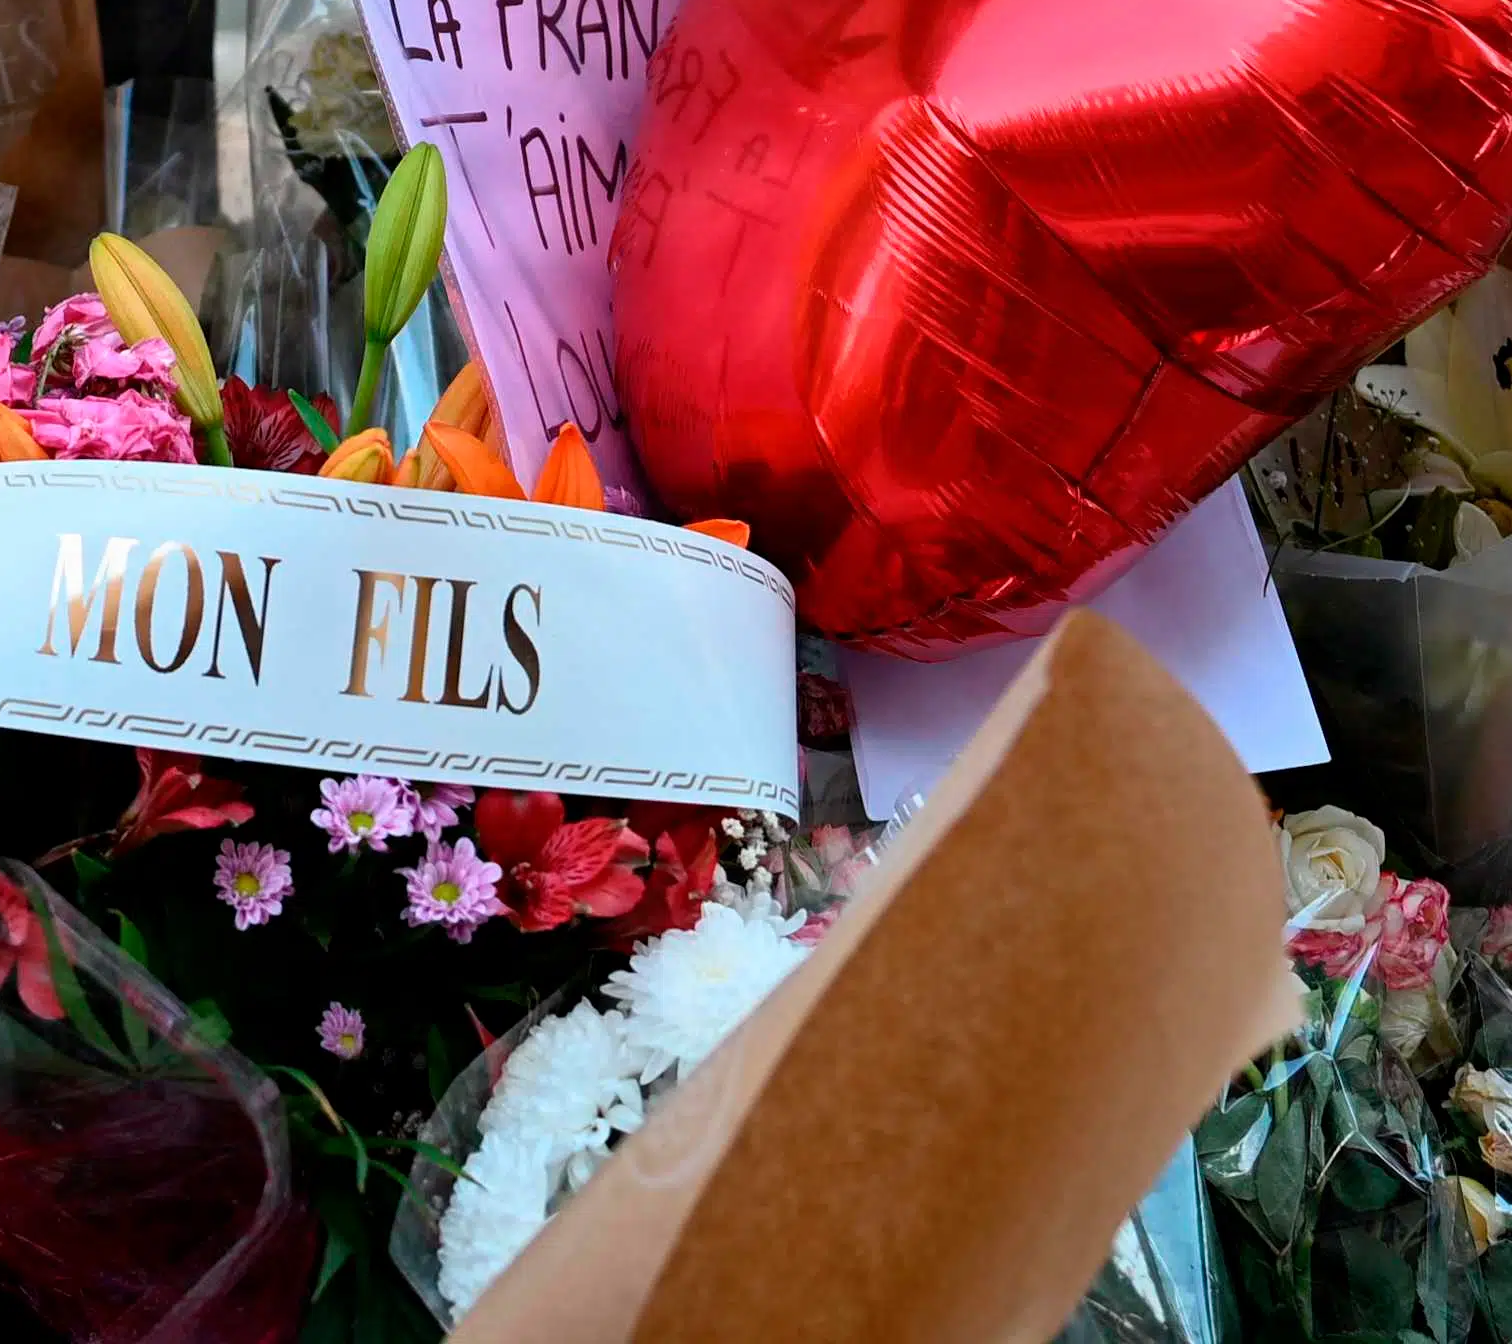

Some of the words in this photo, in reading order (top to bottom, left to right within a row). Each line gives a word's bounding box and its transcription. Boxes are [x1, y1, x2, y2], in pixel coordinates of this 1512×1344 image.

[503, 301, 623, 444] LOU
[38, 533, 283, 687] MON
[340, 566, 543, 717] FILS
